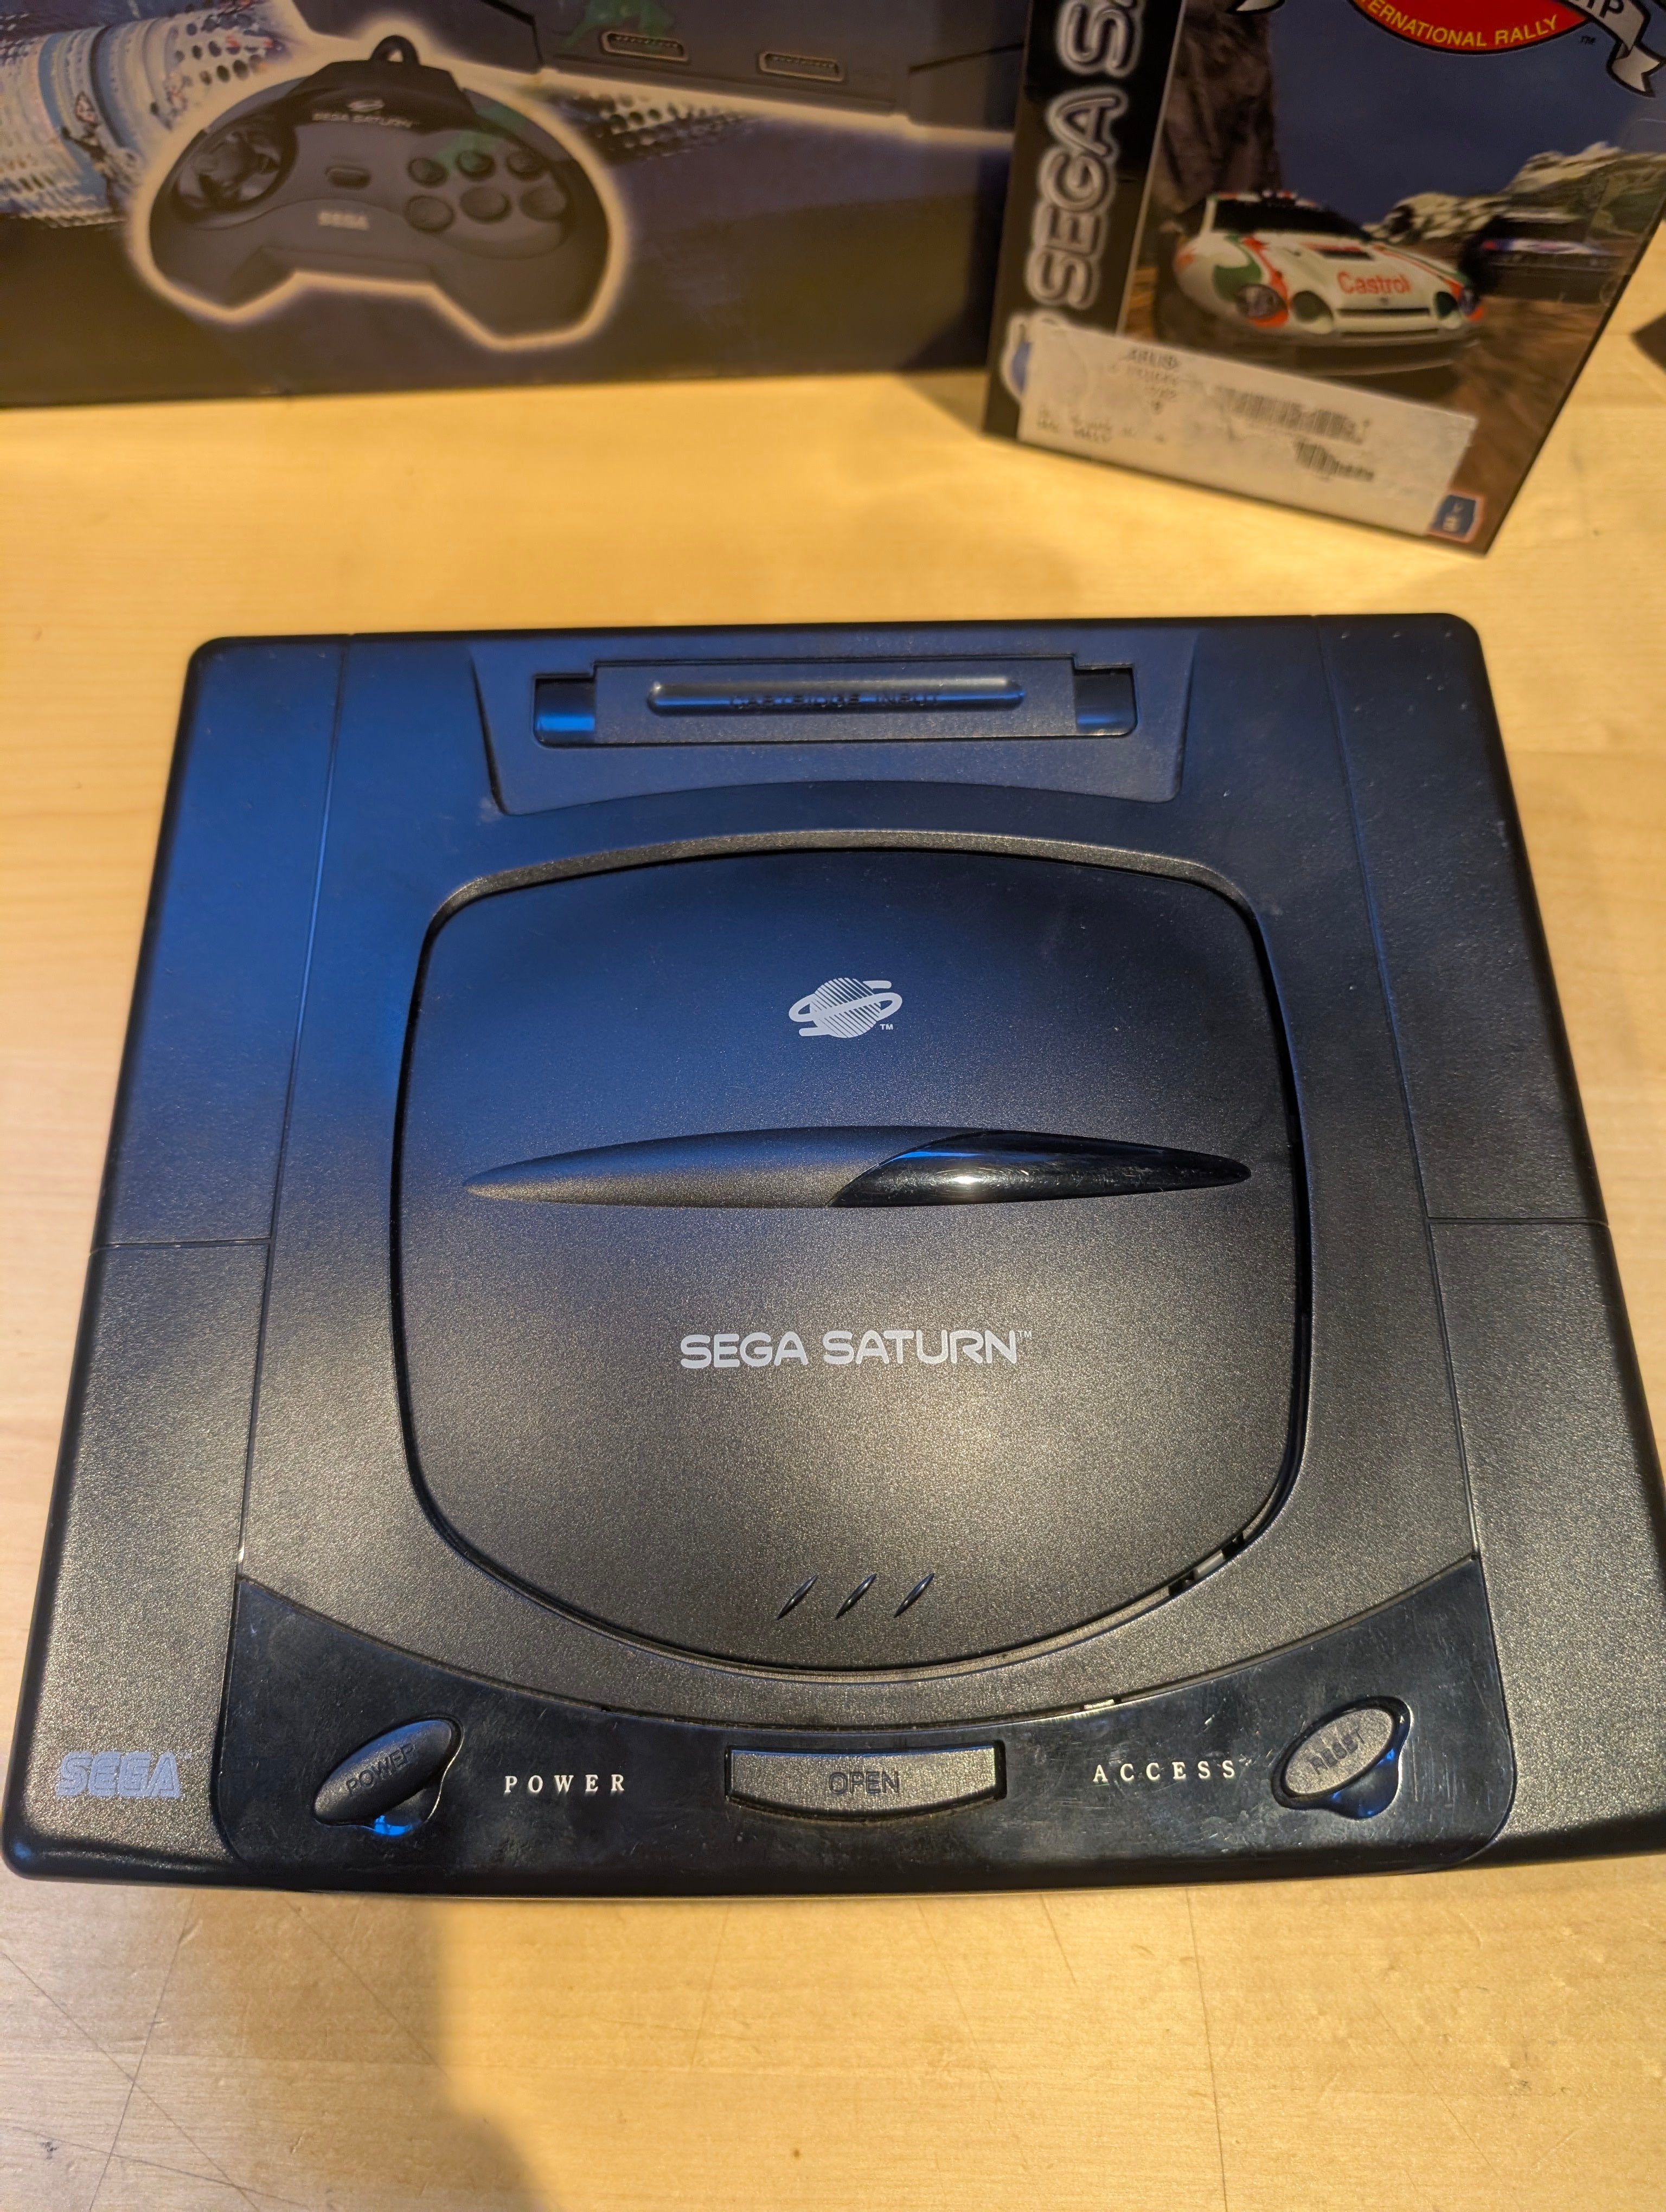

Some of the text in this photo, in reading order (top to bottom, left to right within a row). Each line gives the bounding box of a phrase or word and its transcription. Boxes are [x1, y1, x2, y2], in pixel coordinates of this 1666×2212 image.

[1055, 0, 1144, 77] S
[1355, 0, 1557, 47] ERNATIONAL RALLY
[1025, 87, 1129, 310] SEGA
[1337, 271, 1411, 294] Castrol
[680, 1331, 808, 1369] SEGA
[823, 1329, 1017, 1365] SATURN
[55, 1751, 181, 1798] SEGA
[504, 1774, 625, 1793] POWER
[828, 1771, 900, 1795] OPEN
[1092, 1760, 1236, 1783] ACCESS
